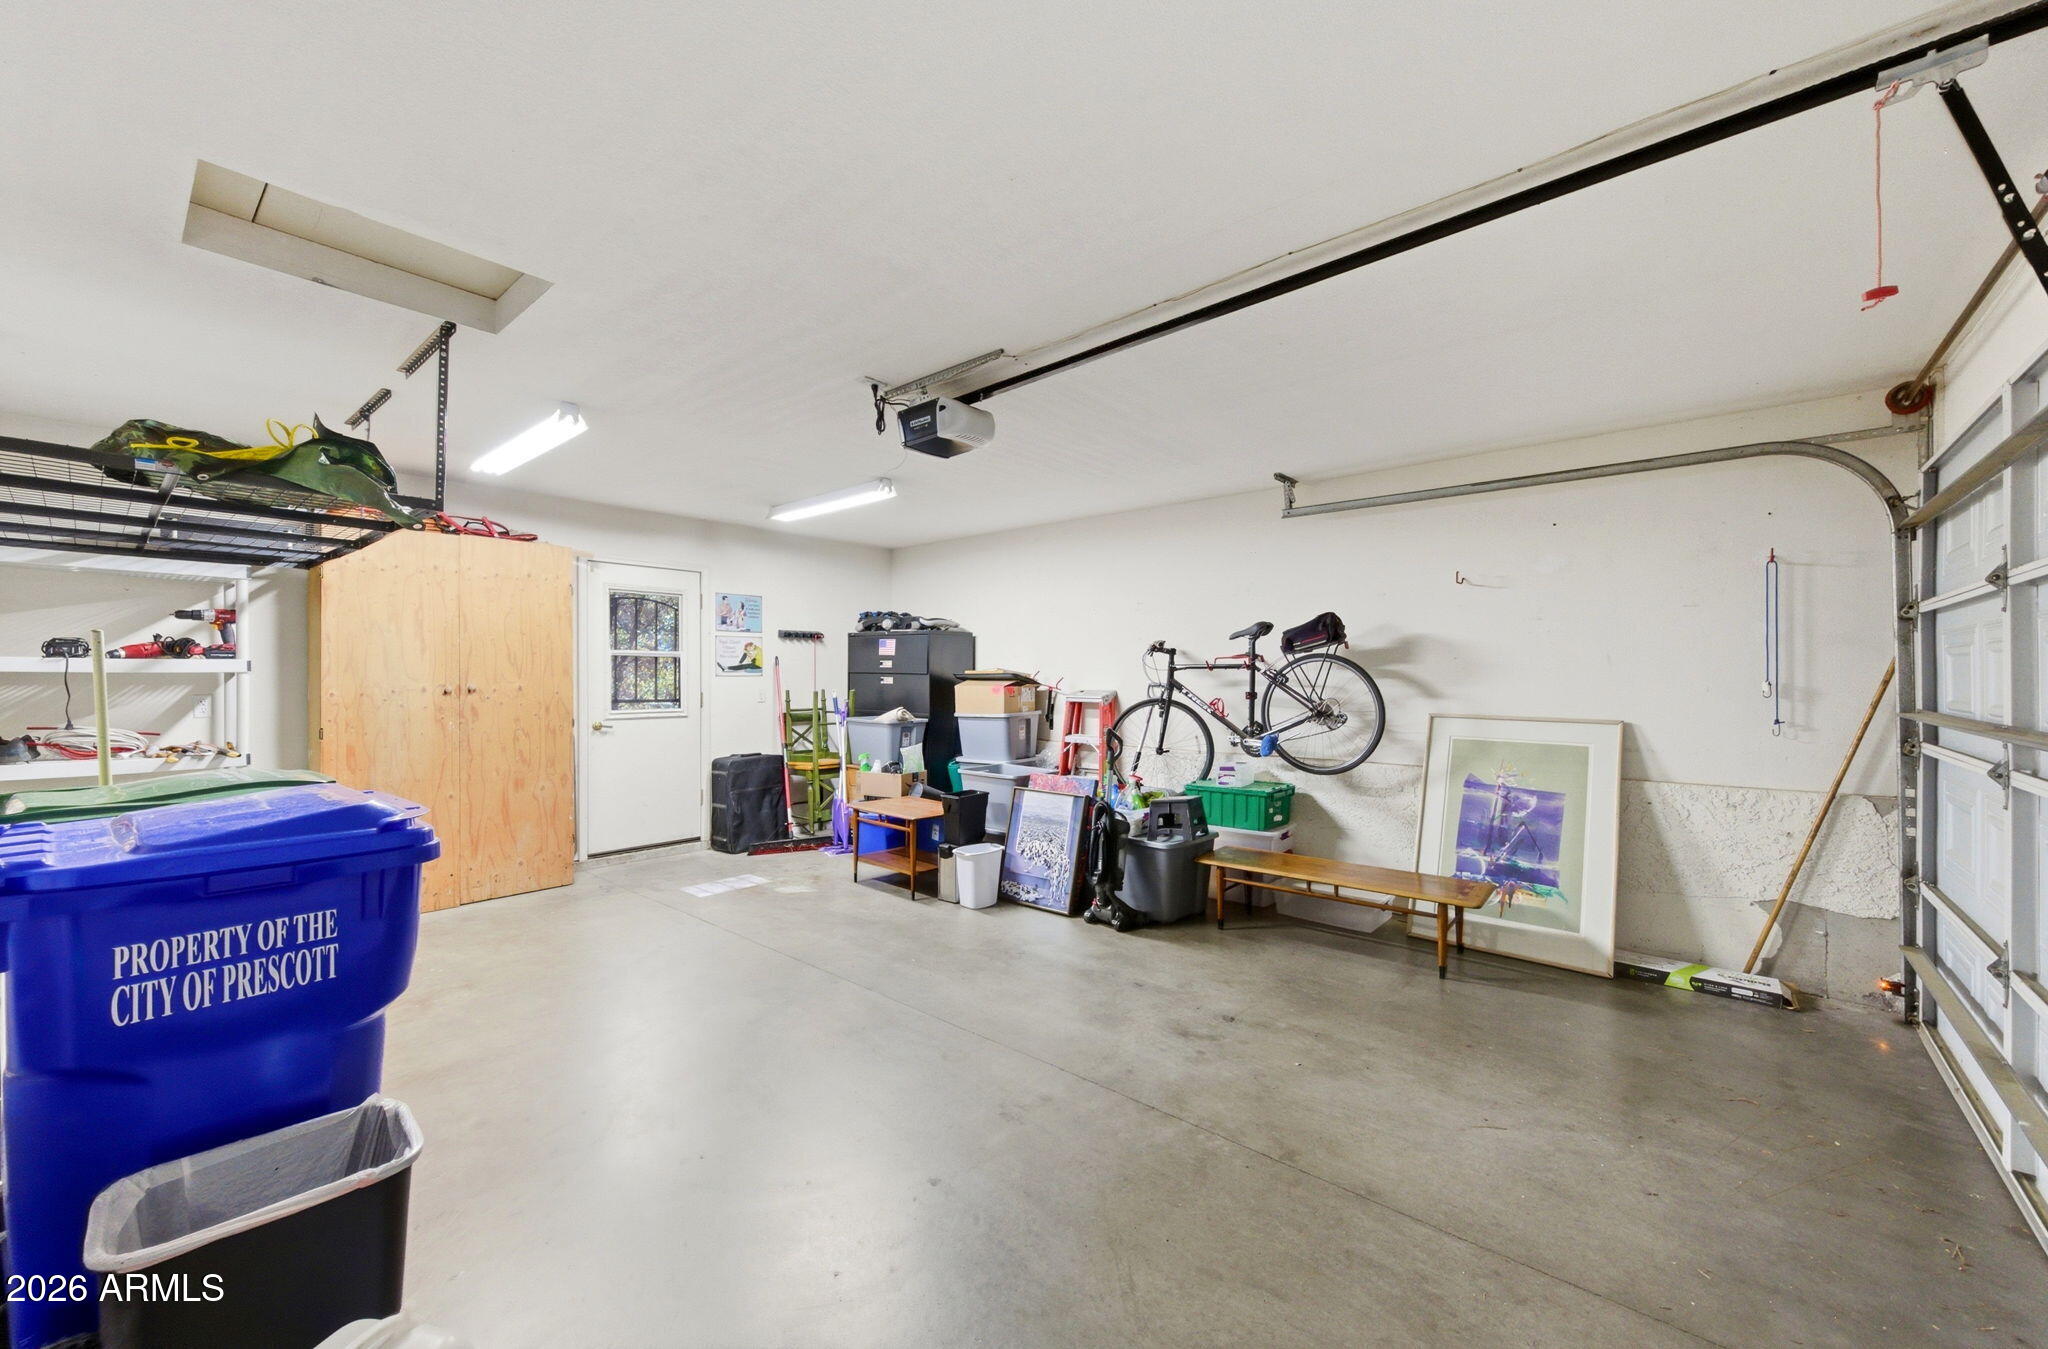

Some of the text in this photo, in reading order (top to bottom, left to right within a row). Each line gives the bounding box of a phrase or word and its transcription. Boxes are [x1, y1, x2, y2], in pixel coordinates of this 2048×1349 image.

[112, 909, 338, 980] PROPERTY OF THE
[110, 943, 339, 1027] CITY OF PRESCOTT
